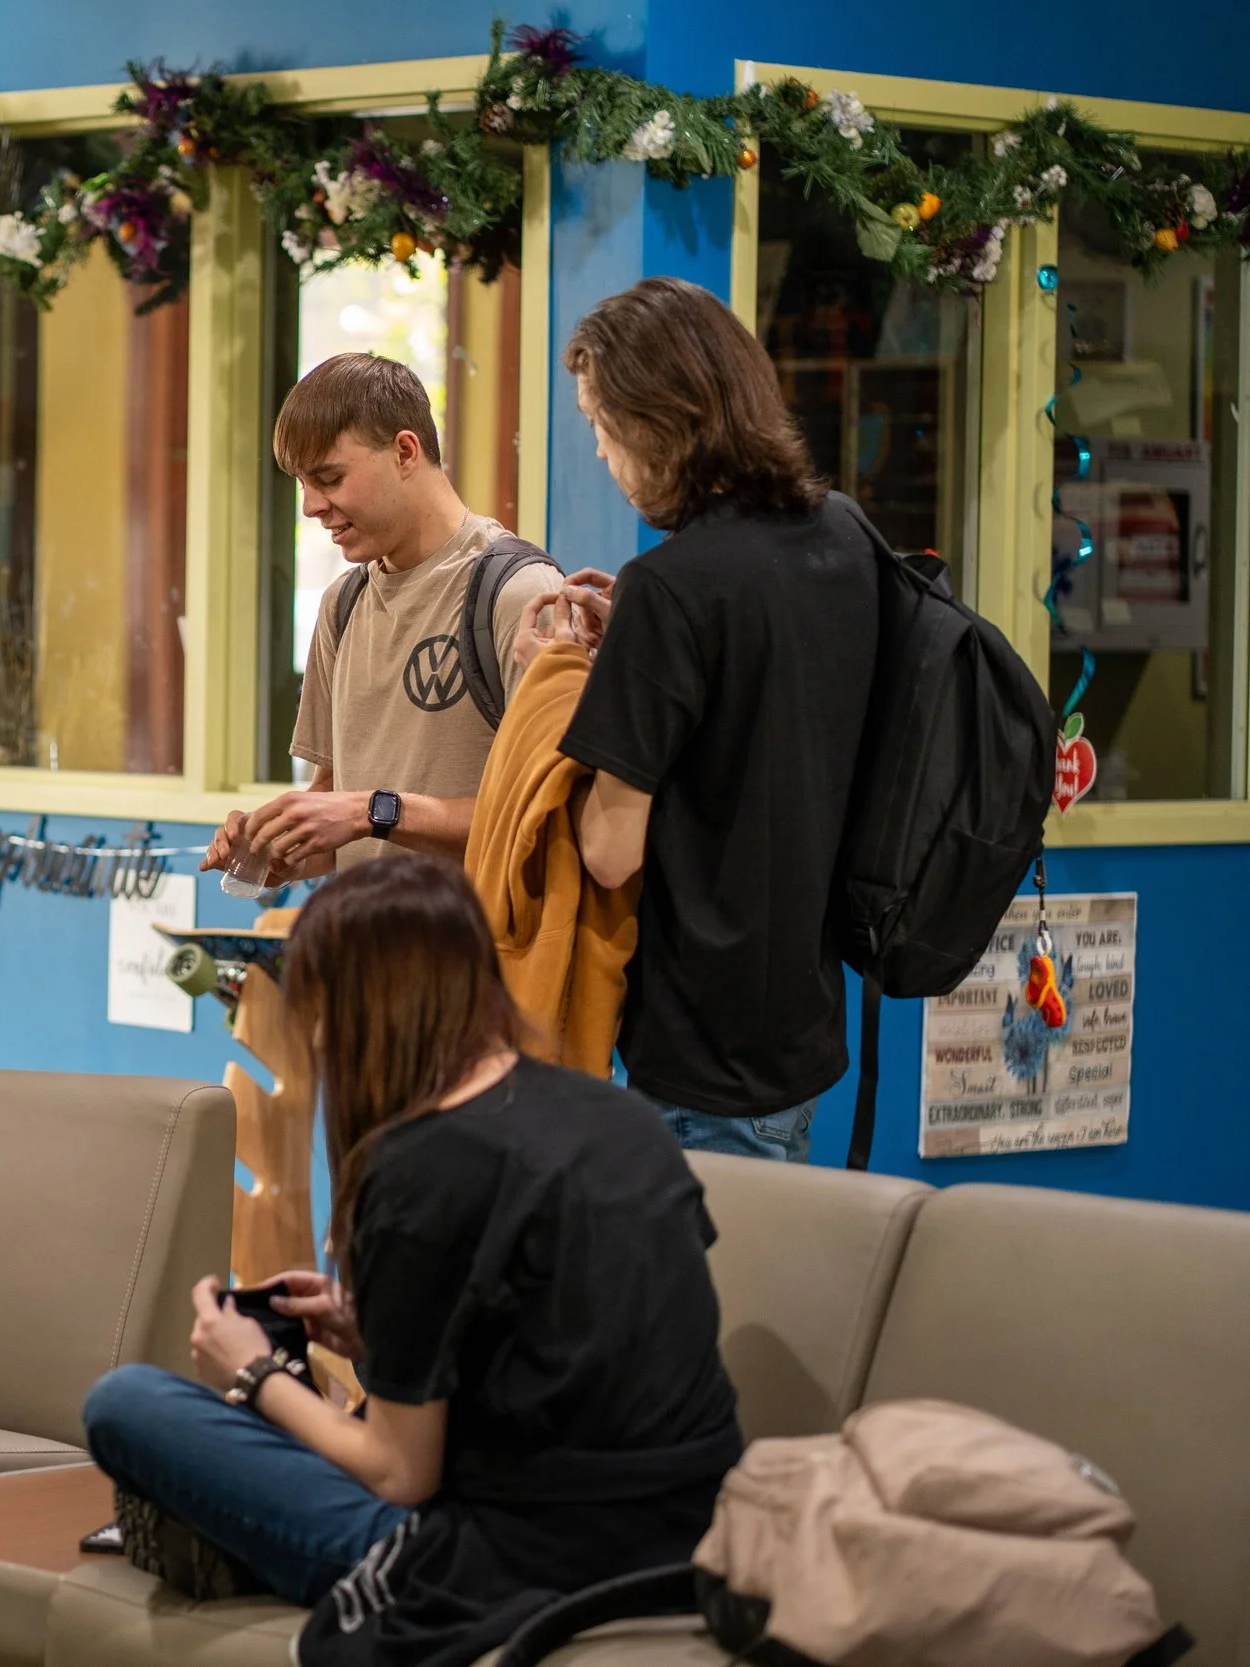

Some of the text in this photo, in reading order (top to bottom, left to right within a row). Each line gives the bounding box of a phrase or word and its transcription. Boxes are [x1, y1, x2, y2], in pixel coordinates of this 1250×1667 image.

[1076, 930, 1096, 948] YOU
[1089, 980, 1128, 1000] LOVED
[935, 1046, 993, 1064] WONDERFUL
[1072, 1034, 1126, 1056] RESPECTED
[1069, 1063, 1113, 1087] Special
